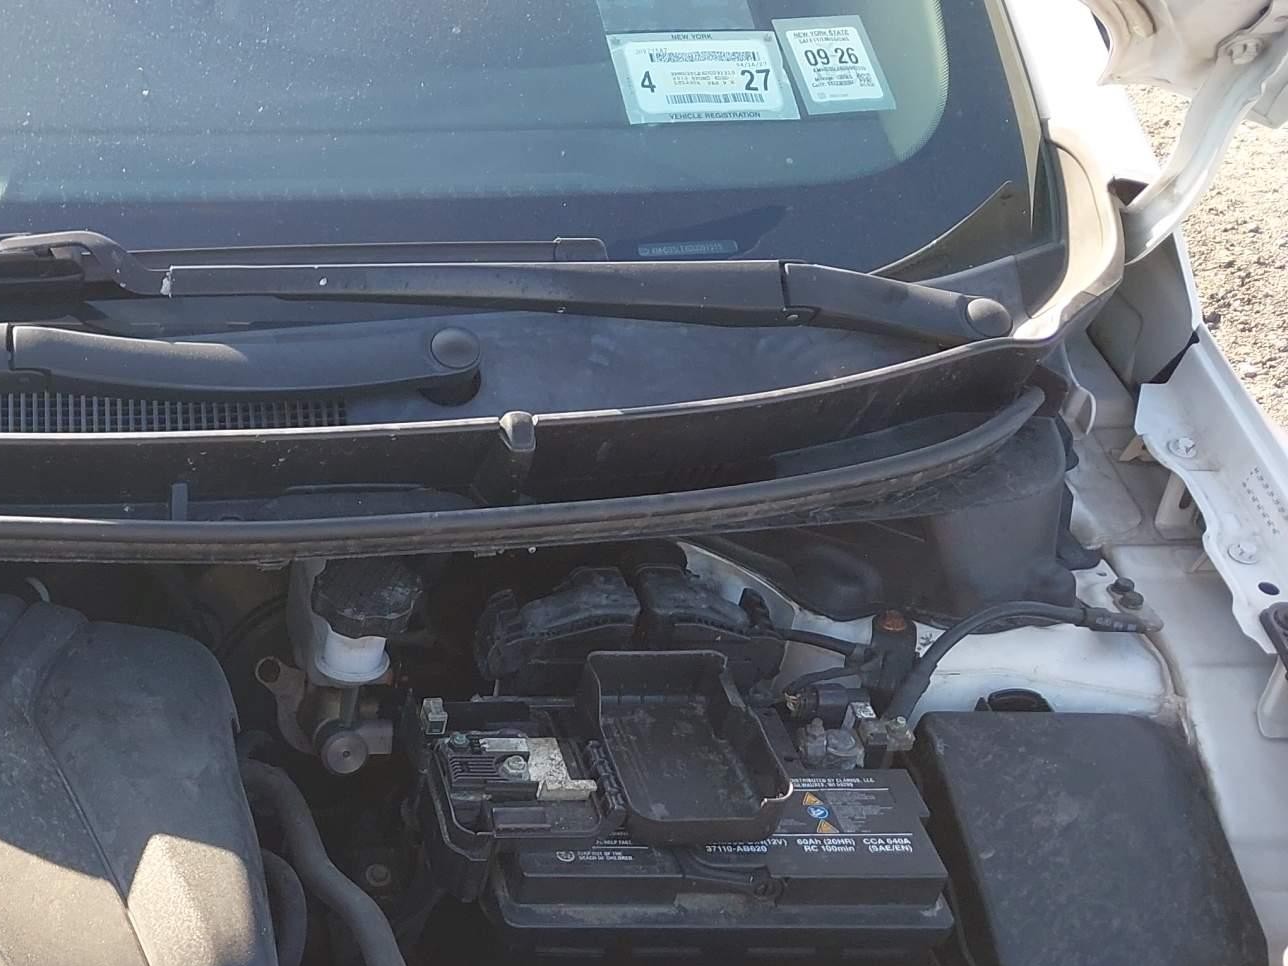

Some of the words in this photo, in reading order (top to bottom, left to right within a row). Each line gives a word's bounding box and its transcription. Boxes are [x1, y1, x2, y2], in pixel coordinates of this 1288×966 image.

[640, 70, 657, 93] 4
[740, 68, 771, 91] 27
[669, 112, 704, 120] VEHICLE
[705, 111, 761, 119] REGISTRATION
[796, 838, 822, 846] 60Ah
[823, 838, 856, 846] (20HR)
[868, 844, 913, 853] (SAE/EN)
